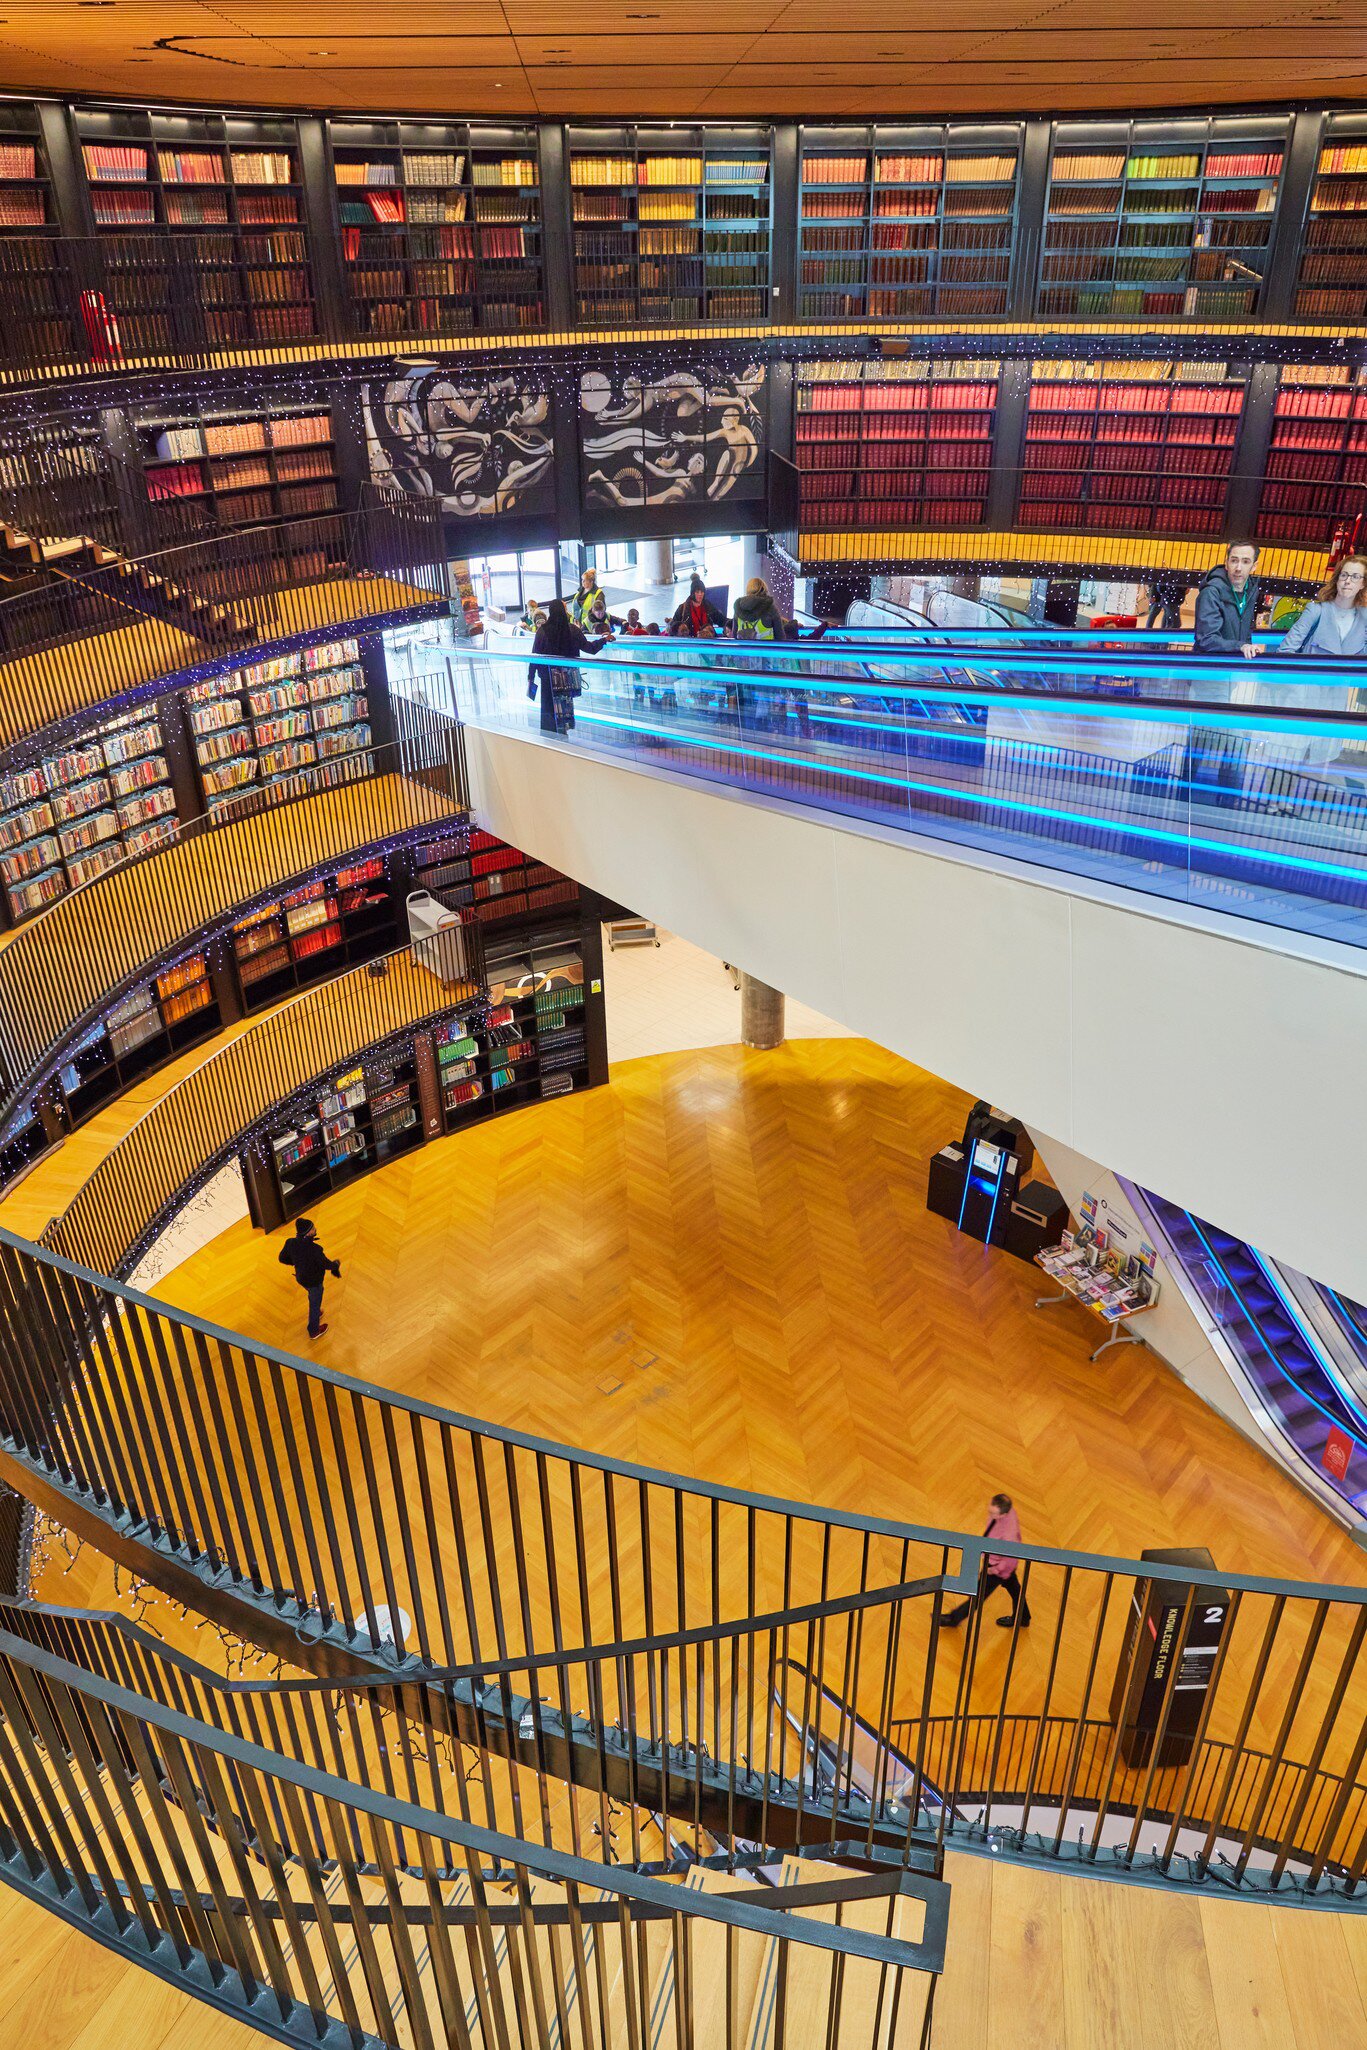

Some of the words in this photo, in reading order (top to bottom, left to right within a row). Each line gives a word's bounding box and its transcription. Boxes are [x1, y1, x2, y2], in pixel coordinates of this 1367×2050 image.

[1203, 1606, 1224, 1624] 2
[1160, 1608, 1179, 1654] KNOWLEDGE
[1154, 1655, 1167, 1679] FLOOR
